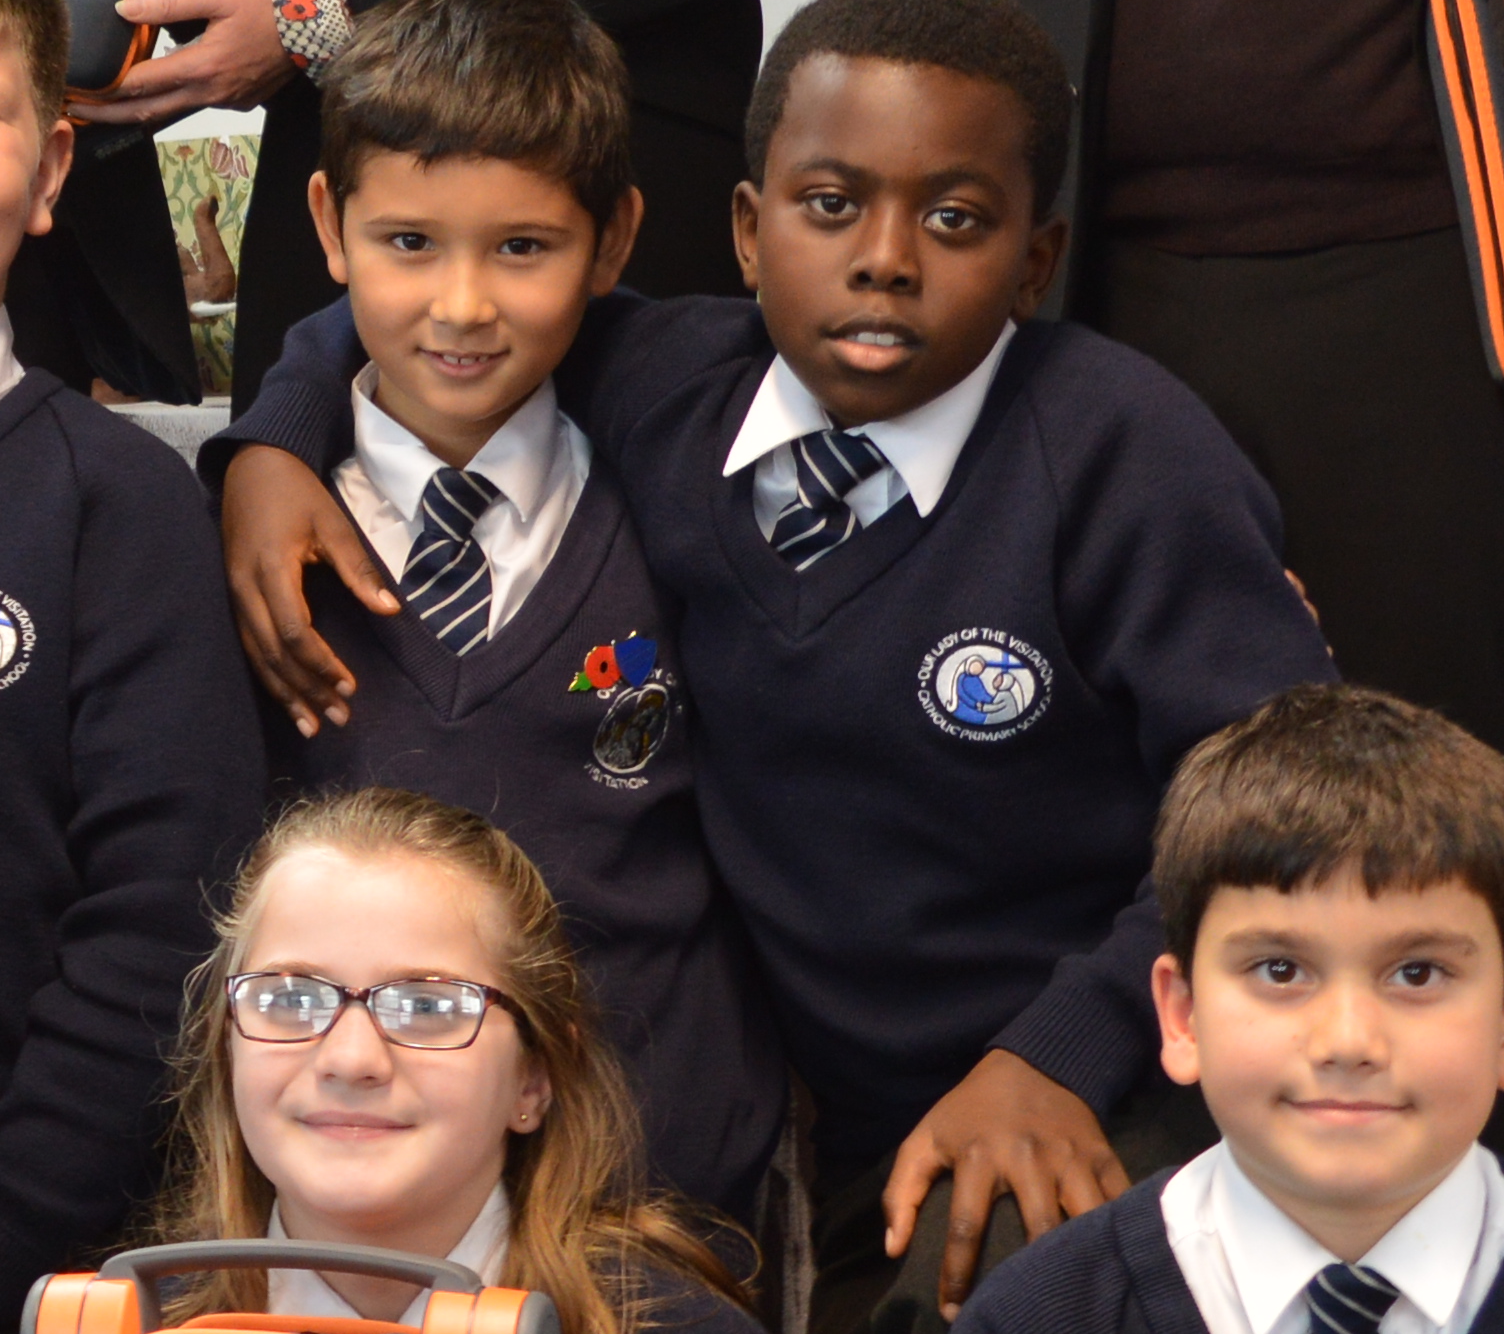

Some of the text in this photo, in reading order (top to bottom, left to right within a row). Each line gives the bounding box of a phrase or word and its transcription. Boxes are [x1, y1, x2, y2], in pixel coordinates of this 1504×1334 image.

[1, 594, 38, 652] VISITATION
[917, 627, 1055, 687] OUR LADY OF THE VISITATION
[917, 689, 962, 736] CATHOLIC
